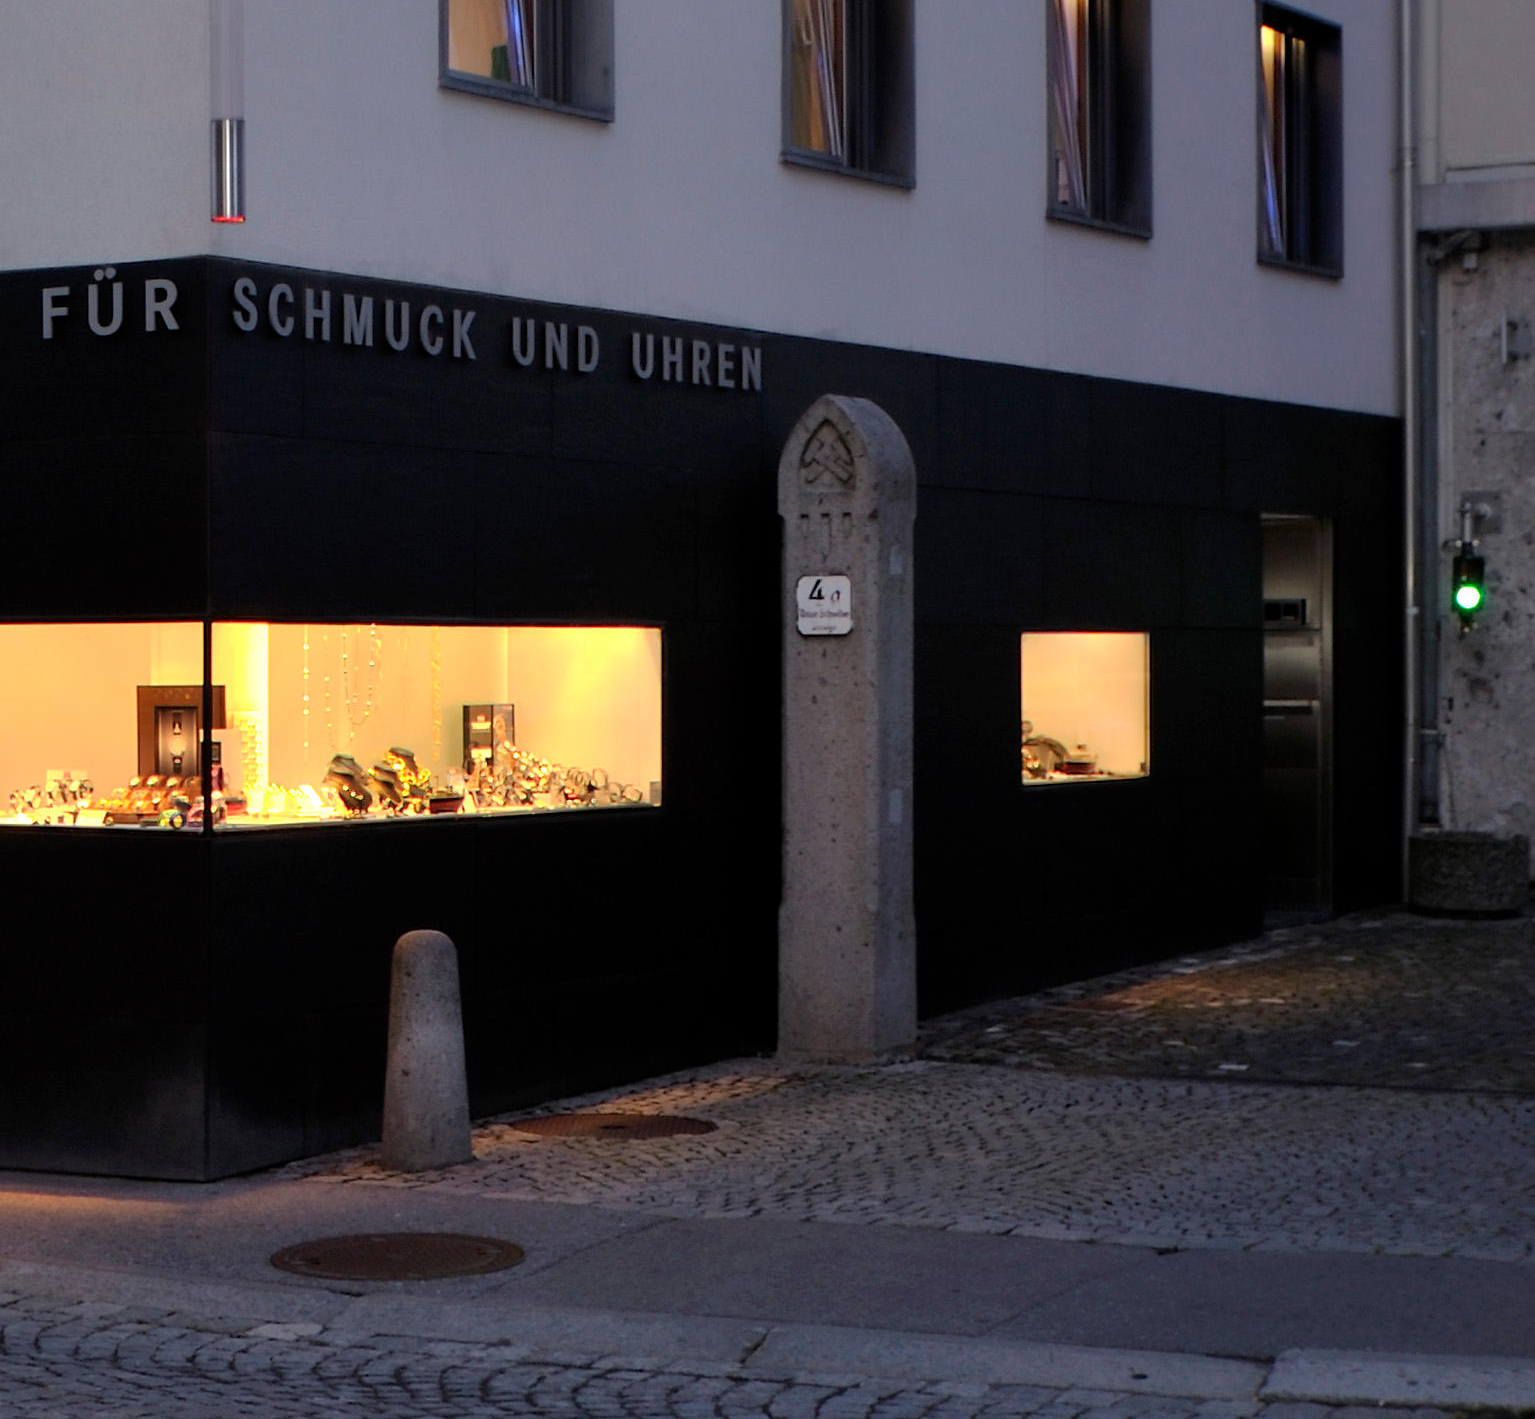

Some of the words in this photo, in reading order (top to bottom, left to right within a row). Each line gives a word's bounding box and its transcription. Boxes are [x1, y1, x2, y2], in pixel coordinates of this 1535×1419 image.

[41, 266, 181, 339] FÜR
[232, 276, 477, 361] SCHMUCK
[511, 316, 600, 374] UND
[631, 331, 763, 391] UHREN
